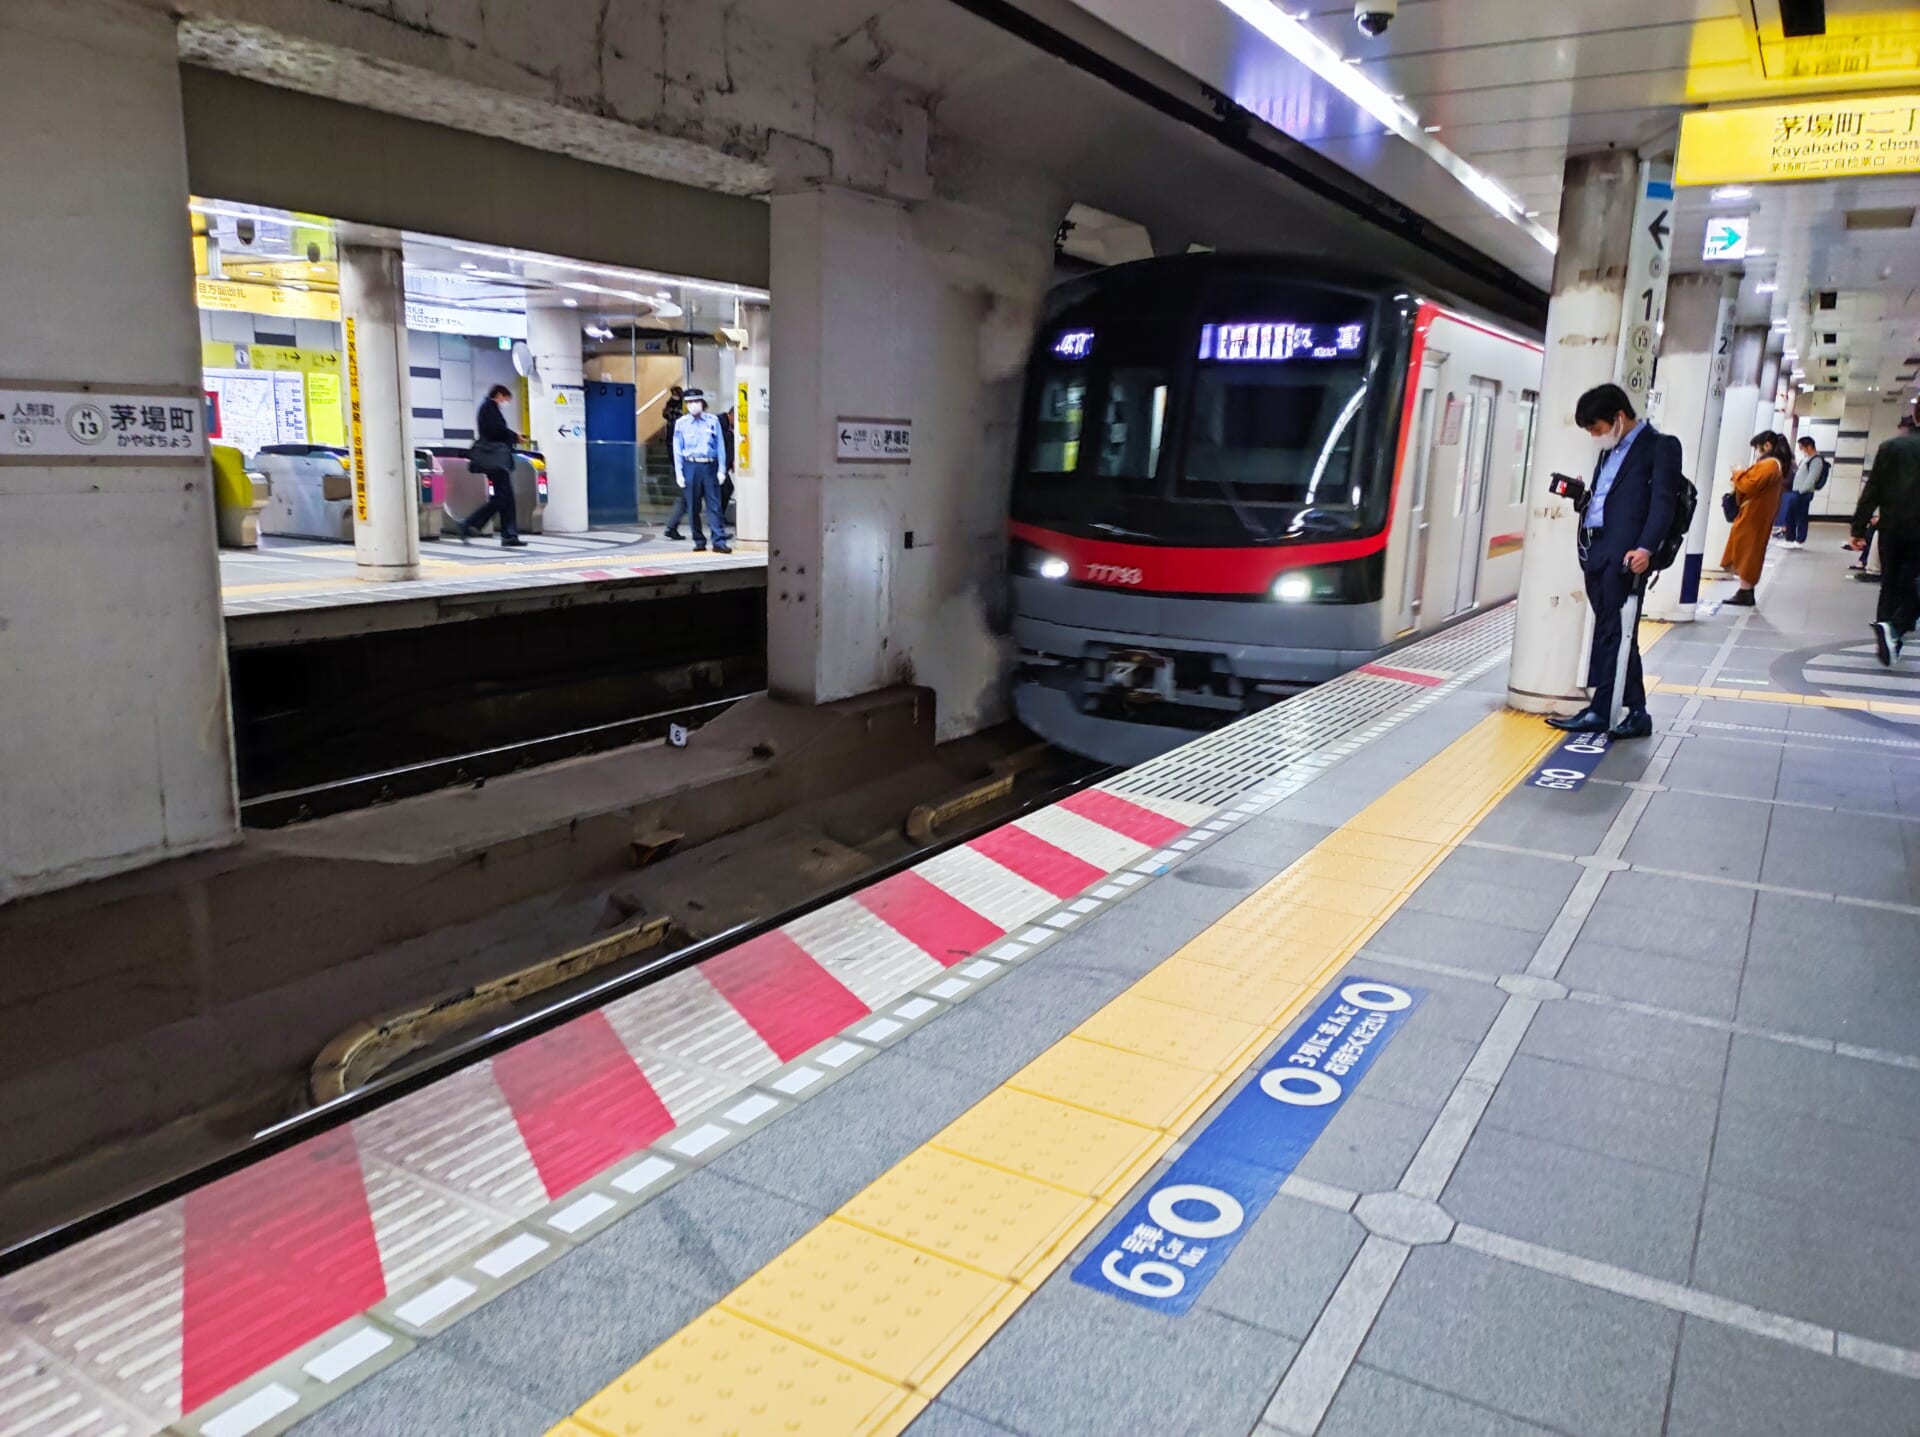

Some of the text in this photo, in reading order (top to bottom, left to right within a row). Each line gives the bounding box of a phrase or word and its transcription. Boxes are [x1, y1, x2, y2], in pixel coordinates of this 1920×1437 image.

[1772, 140, 1860, 159] Kayabacho
[1865, 138, 1874, 151] 2
[1641, 288, 1653, 321] 1
[1718, 336, 1727, 355] 2
[1631, 377, 1642, 388] 01
[13, 403, 54, 417] 人形町
[82, 411, 92, 420] H
[109, 404, 195, 433] 茅場町
[78, 422, 99, 436] 13
[117, 434, 193, 448] かやばちょう
[1535, 780, 1574, 789] 6
[1289, 1004, 1359, 1068] 3列に並んで
[1323, 1011, 1389, 1076] お待ちください
[1101, 1249, 1185, 1298] 6
